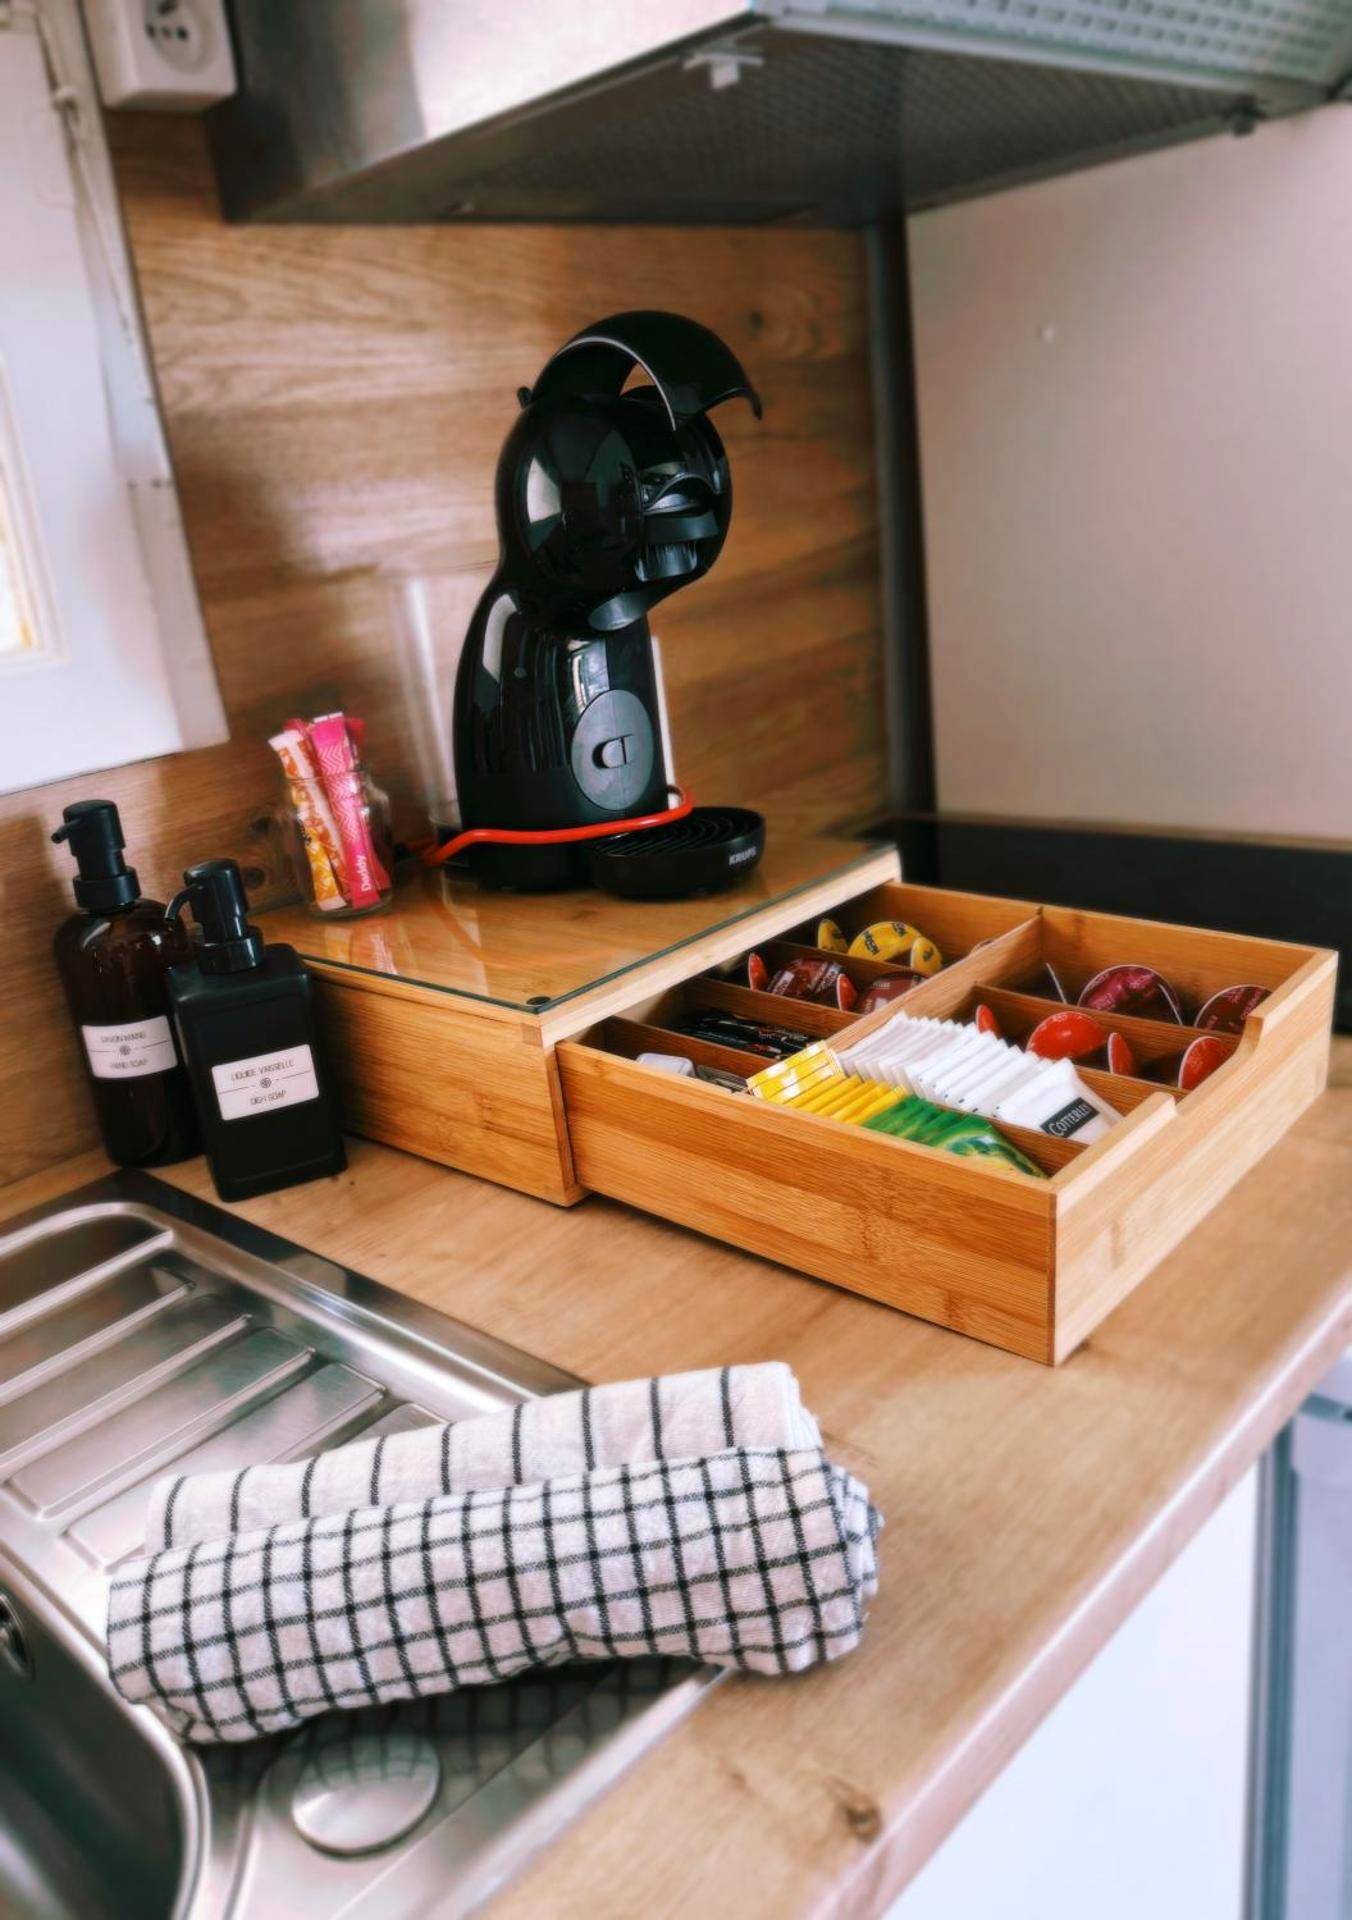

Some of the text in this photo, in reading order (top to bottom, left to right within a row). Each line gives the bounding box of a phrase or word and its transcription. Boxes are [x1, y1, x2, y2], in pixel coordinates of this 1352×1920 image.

[356, 854, 371, 892] Daddy
[258, 1059, 295, 1075] VAISSELLE
[268, 1090, 287, 1102] SOAP
